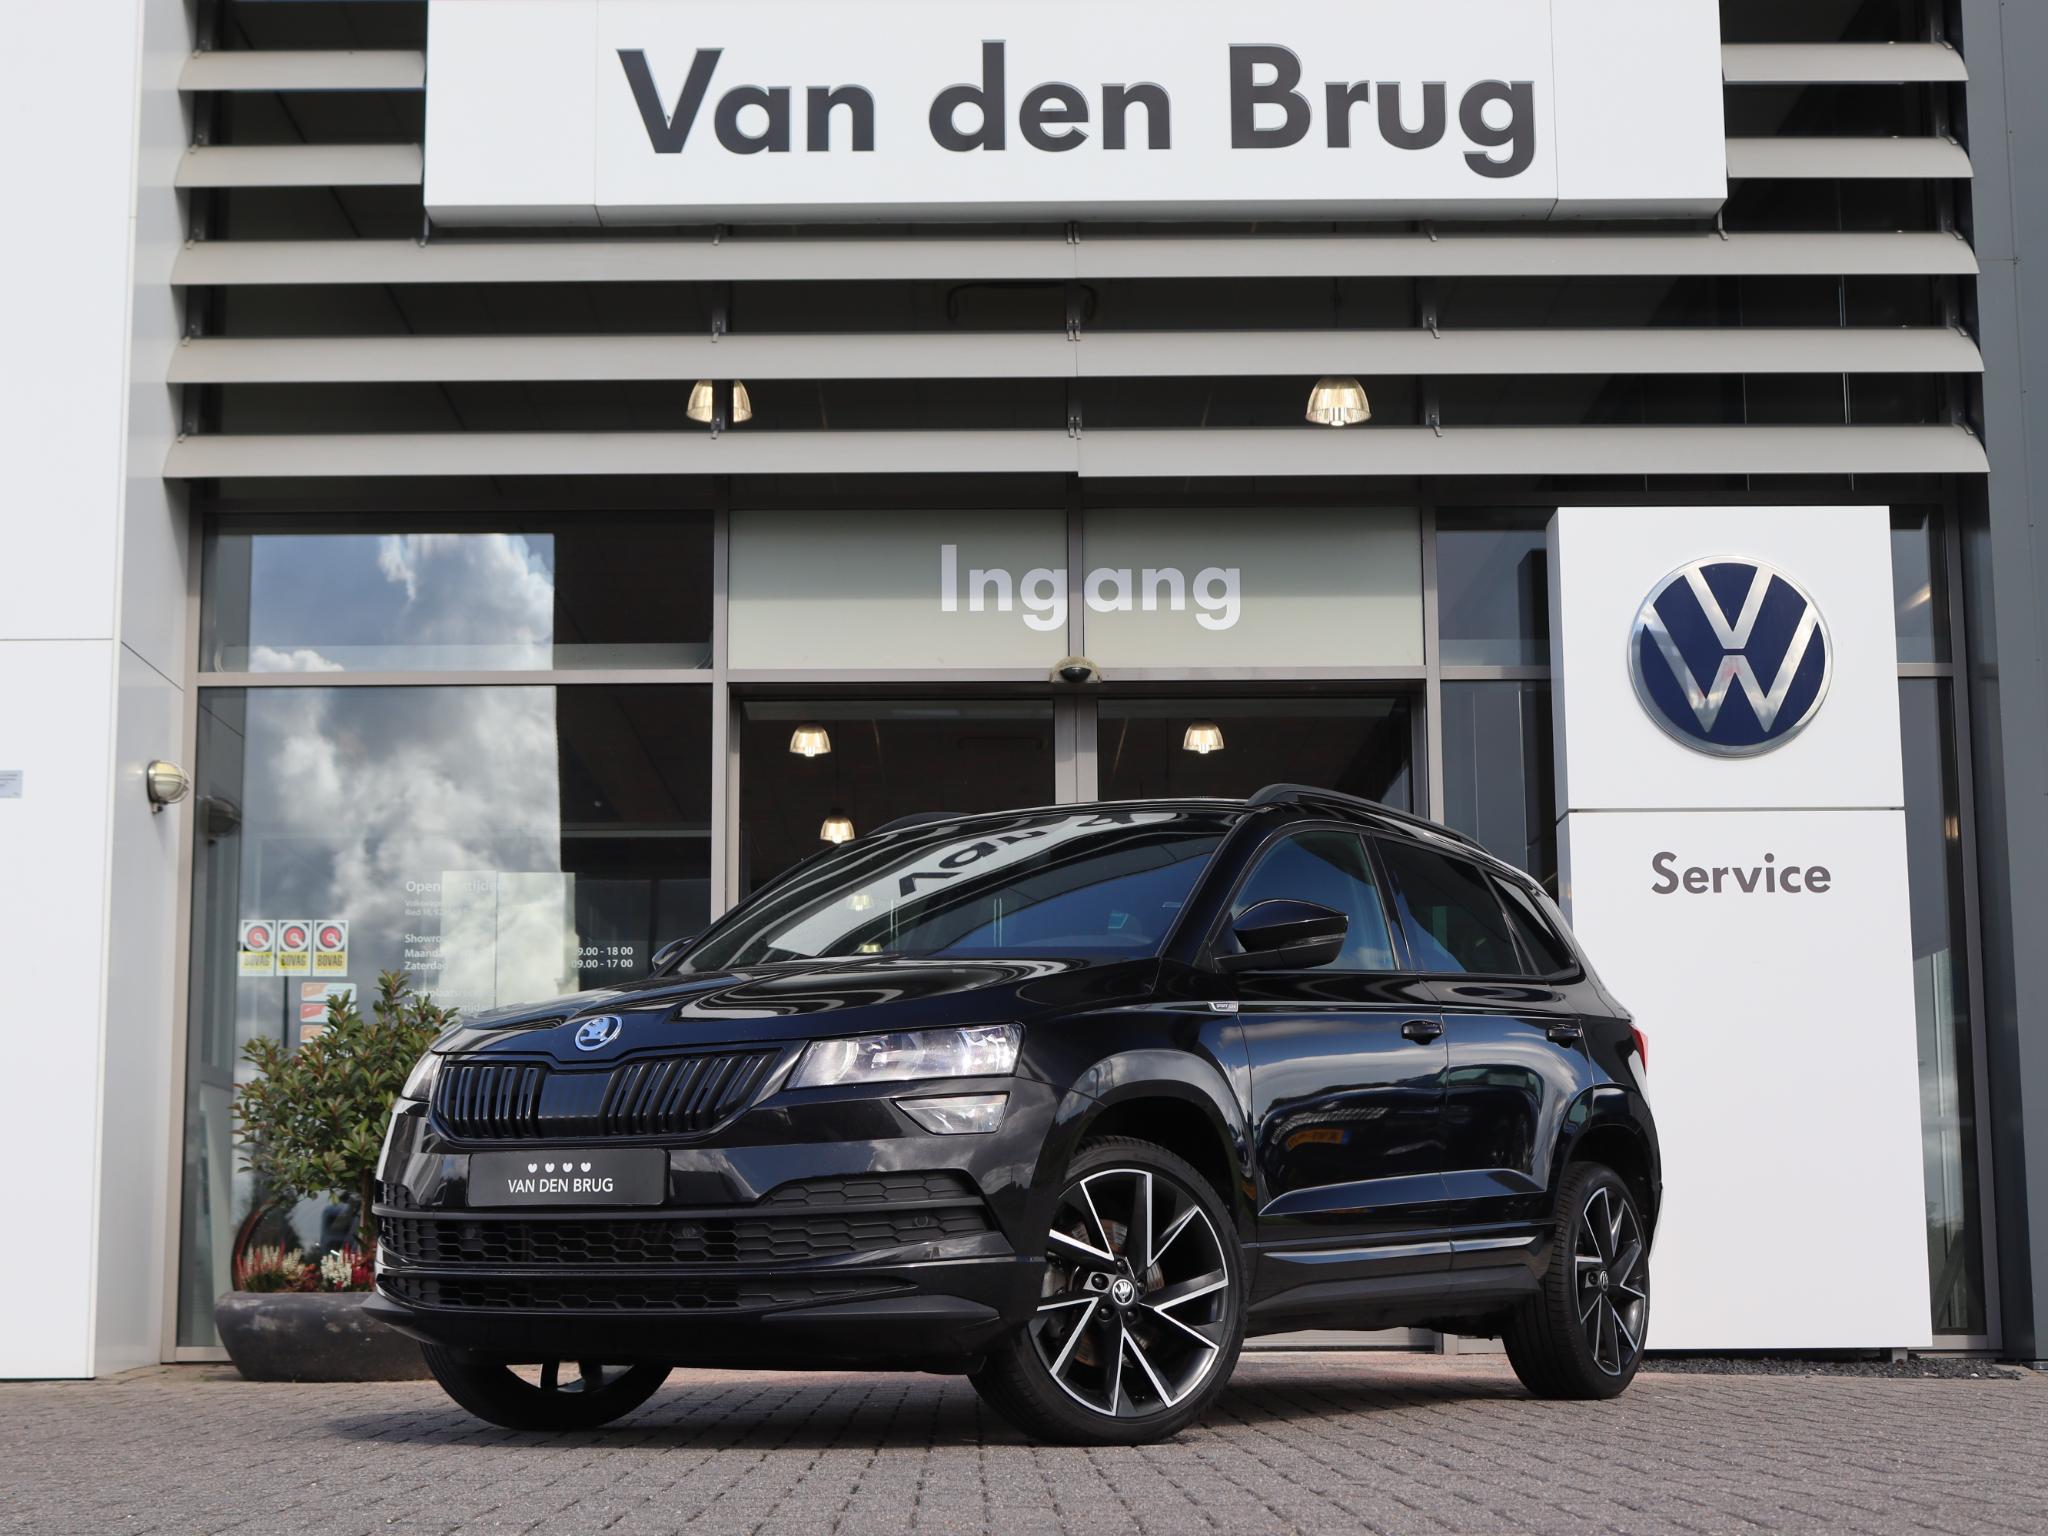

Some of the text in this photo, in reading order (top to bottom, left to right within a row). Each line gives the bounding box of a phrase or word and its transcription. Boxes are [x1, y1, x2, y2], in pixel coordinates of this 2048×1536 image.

[616, 39, 1536, 179] Van den Brug
[941, 544, 1241, 631] Ingang
[1651, 851, 1831, 894] Service
[317, 954, 343, 966] BOVAG
[508, 1178, 613, 1193] VAN DEN BRUG
